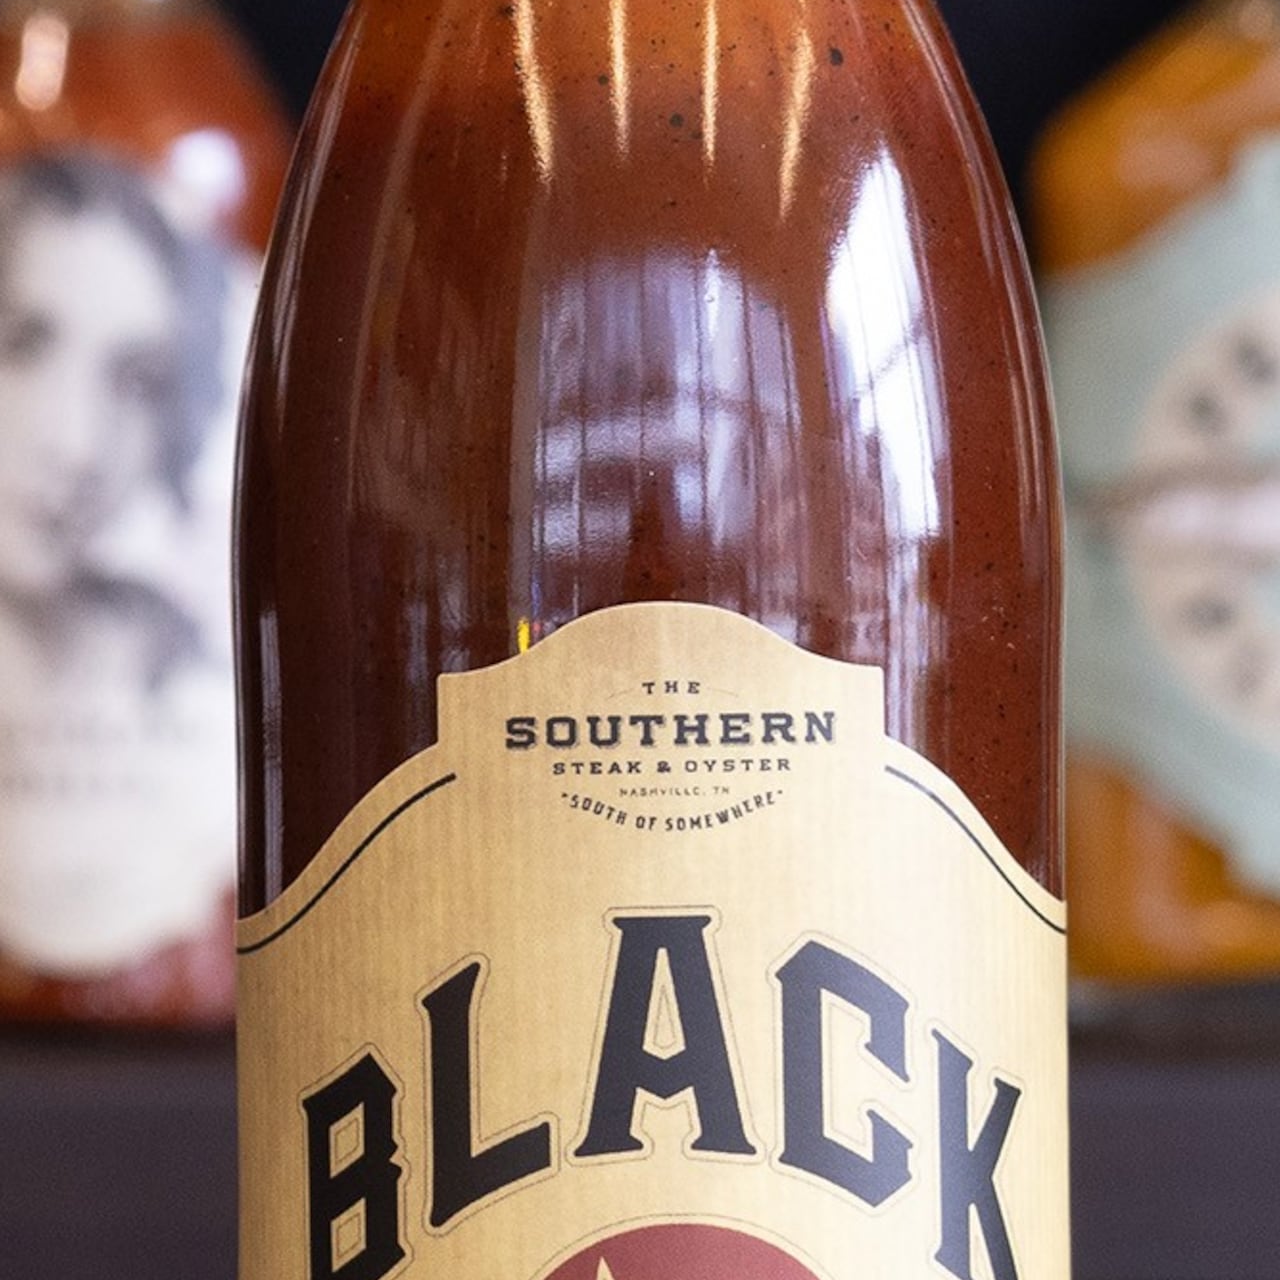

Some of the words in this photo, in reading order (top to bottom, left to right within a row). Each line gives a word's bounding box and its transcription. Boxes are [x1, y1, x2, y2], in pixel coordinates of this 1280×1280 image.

[641, 680, 702, 696] THE
[504, 710, 837, 751] SOUTHERN
[552, 760, 642, 776] STEAK
[656, 760, 673, 774] &
[684, 757, 792, 774] OYSTER
[713, 785, 730, 796] TN
[635, 816, 658, 831] OF
